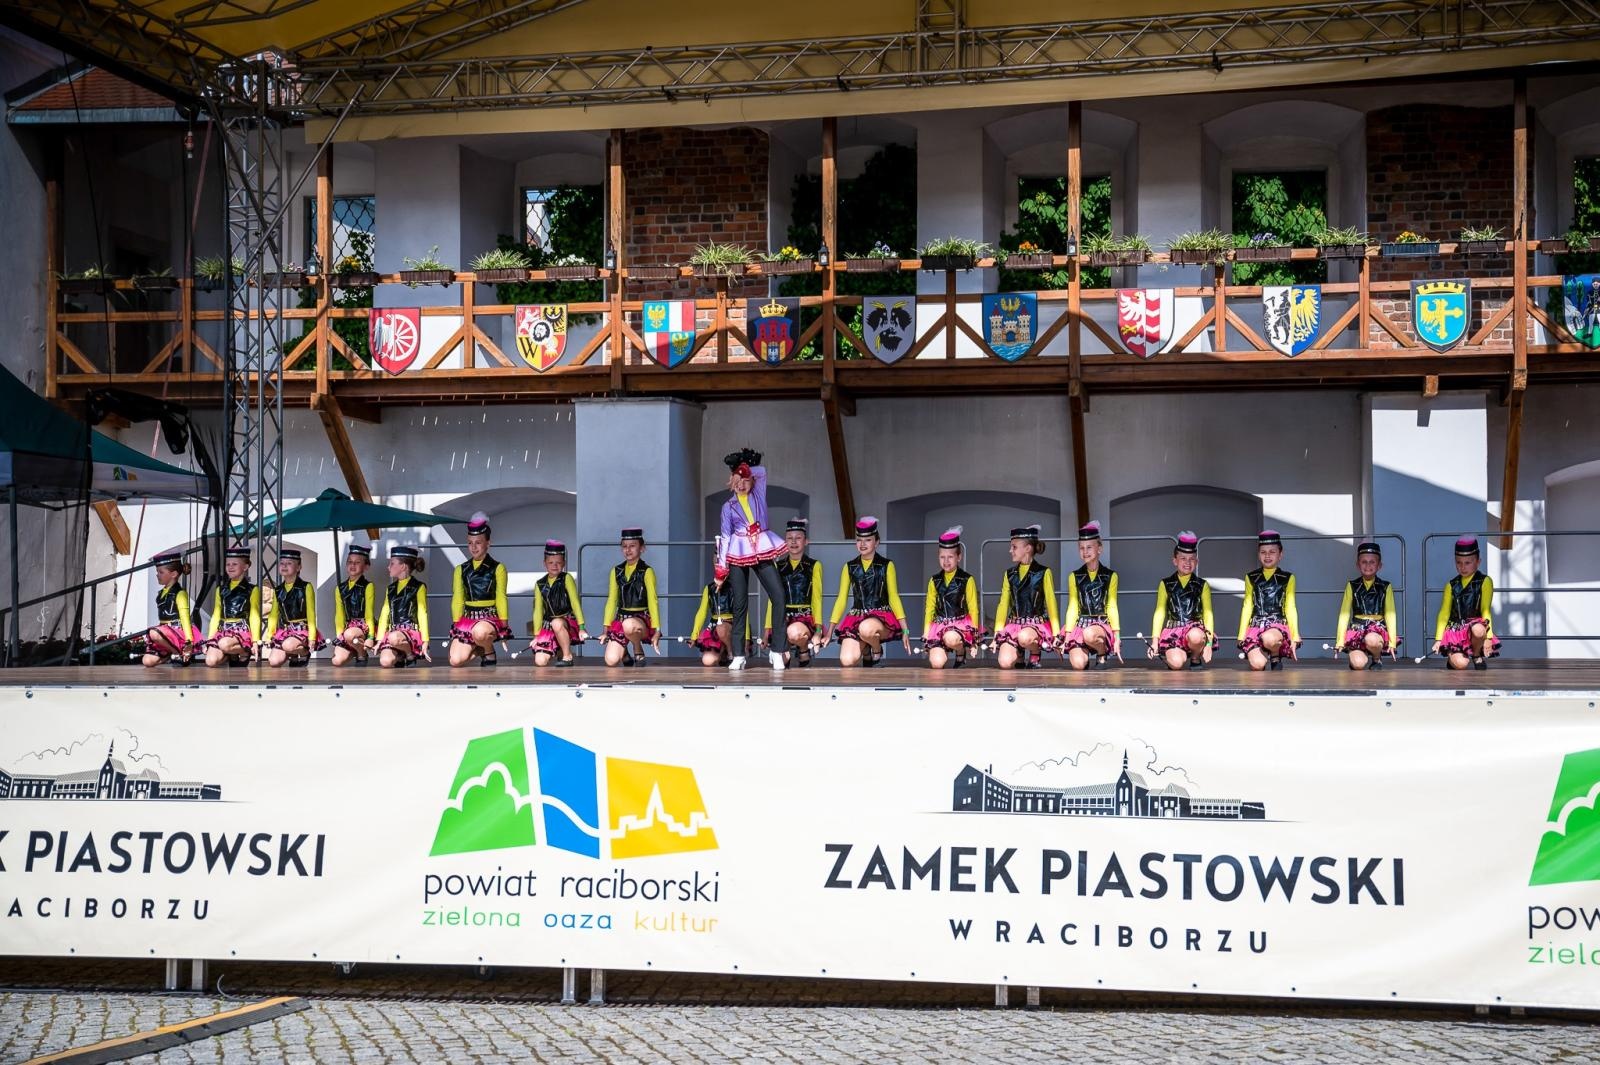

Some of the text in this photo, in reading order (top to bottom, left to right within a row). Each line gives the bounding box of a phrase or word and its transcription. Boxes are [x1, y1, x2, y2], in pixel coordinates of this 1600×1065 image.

[25, 831, 326, 877] PIASTOWSKI
[424, 866, 720, 904] powiat raciborski
[823, 843, 1405, 906] ZAMEK PIASTOWSKI
[423, 907, 719, 933] zielona oaza kultur
[949, 919, 1268, 954] W RACIBORZU
